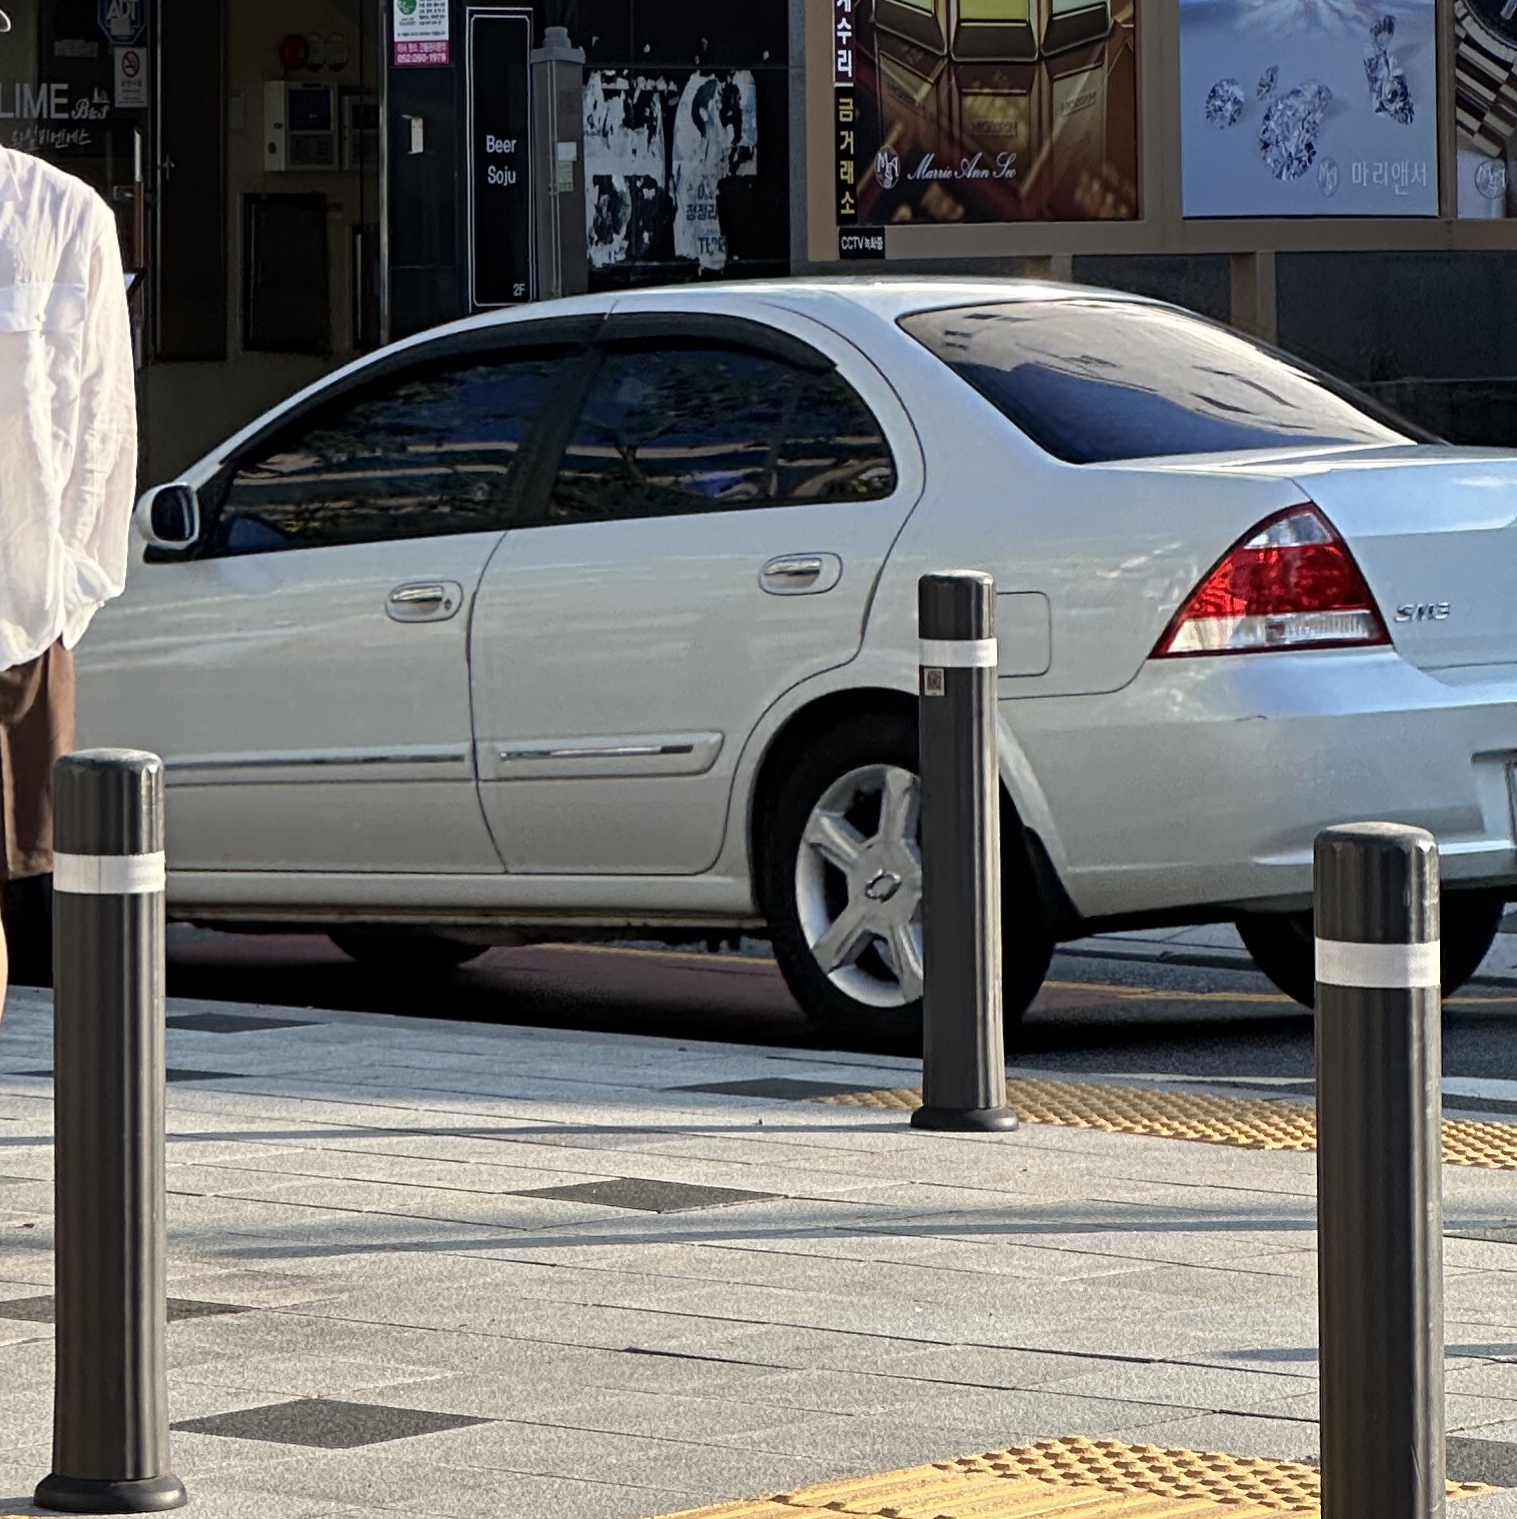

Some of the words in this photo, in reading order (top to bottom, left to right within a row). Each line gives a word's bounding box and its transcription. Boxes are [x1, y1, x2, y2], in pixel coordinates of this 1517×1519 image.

[486, 134, 517, 153] Beer
[838, 97, 856, 215] 금거래소
[487, 165, 517, 186] Soju
[1351, 161, 1427, 196] 마리앤서
[841, 235, 864, 250] CCTV
[513, 283, 526, 297] 2F
[1394, 602, 1450, 623] SM3
